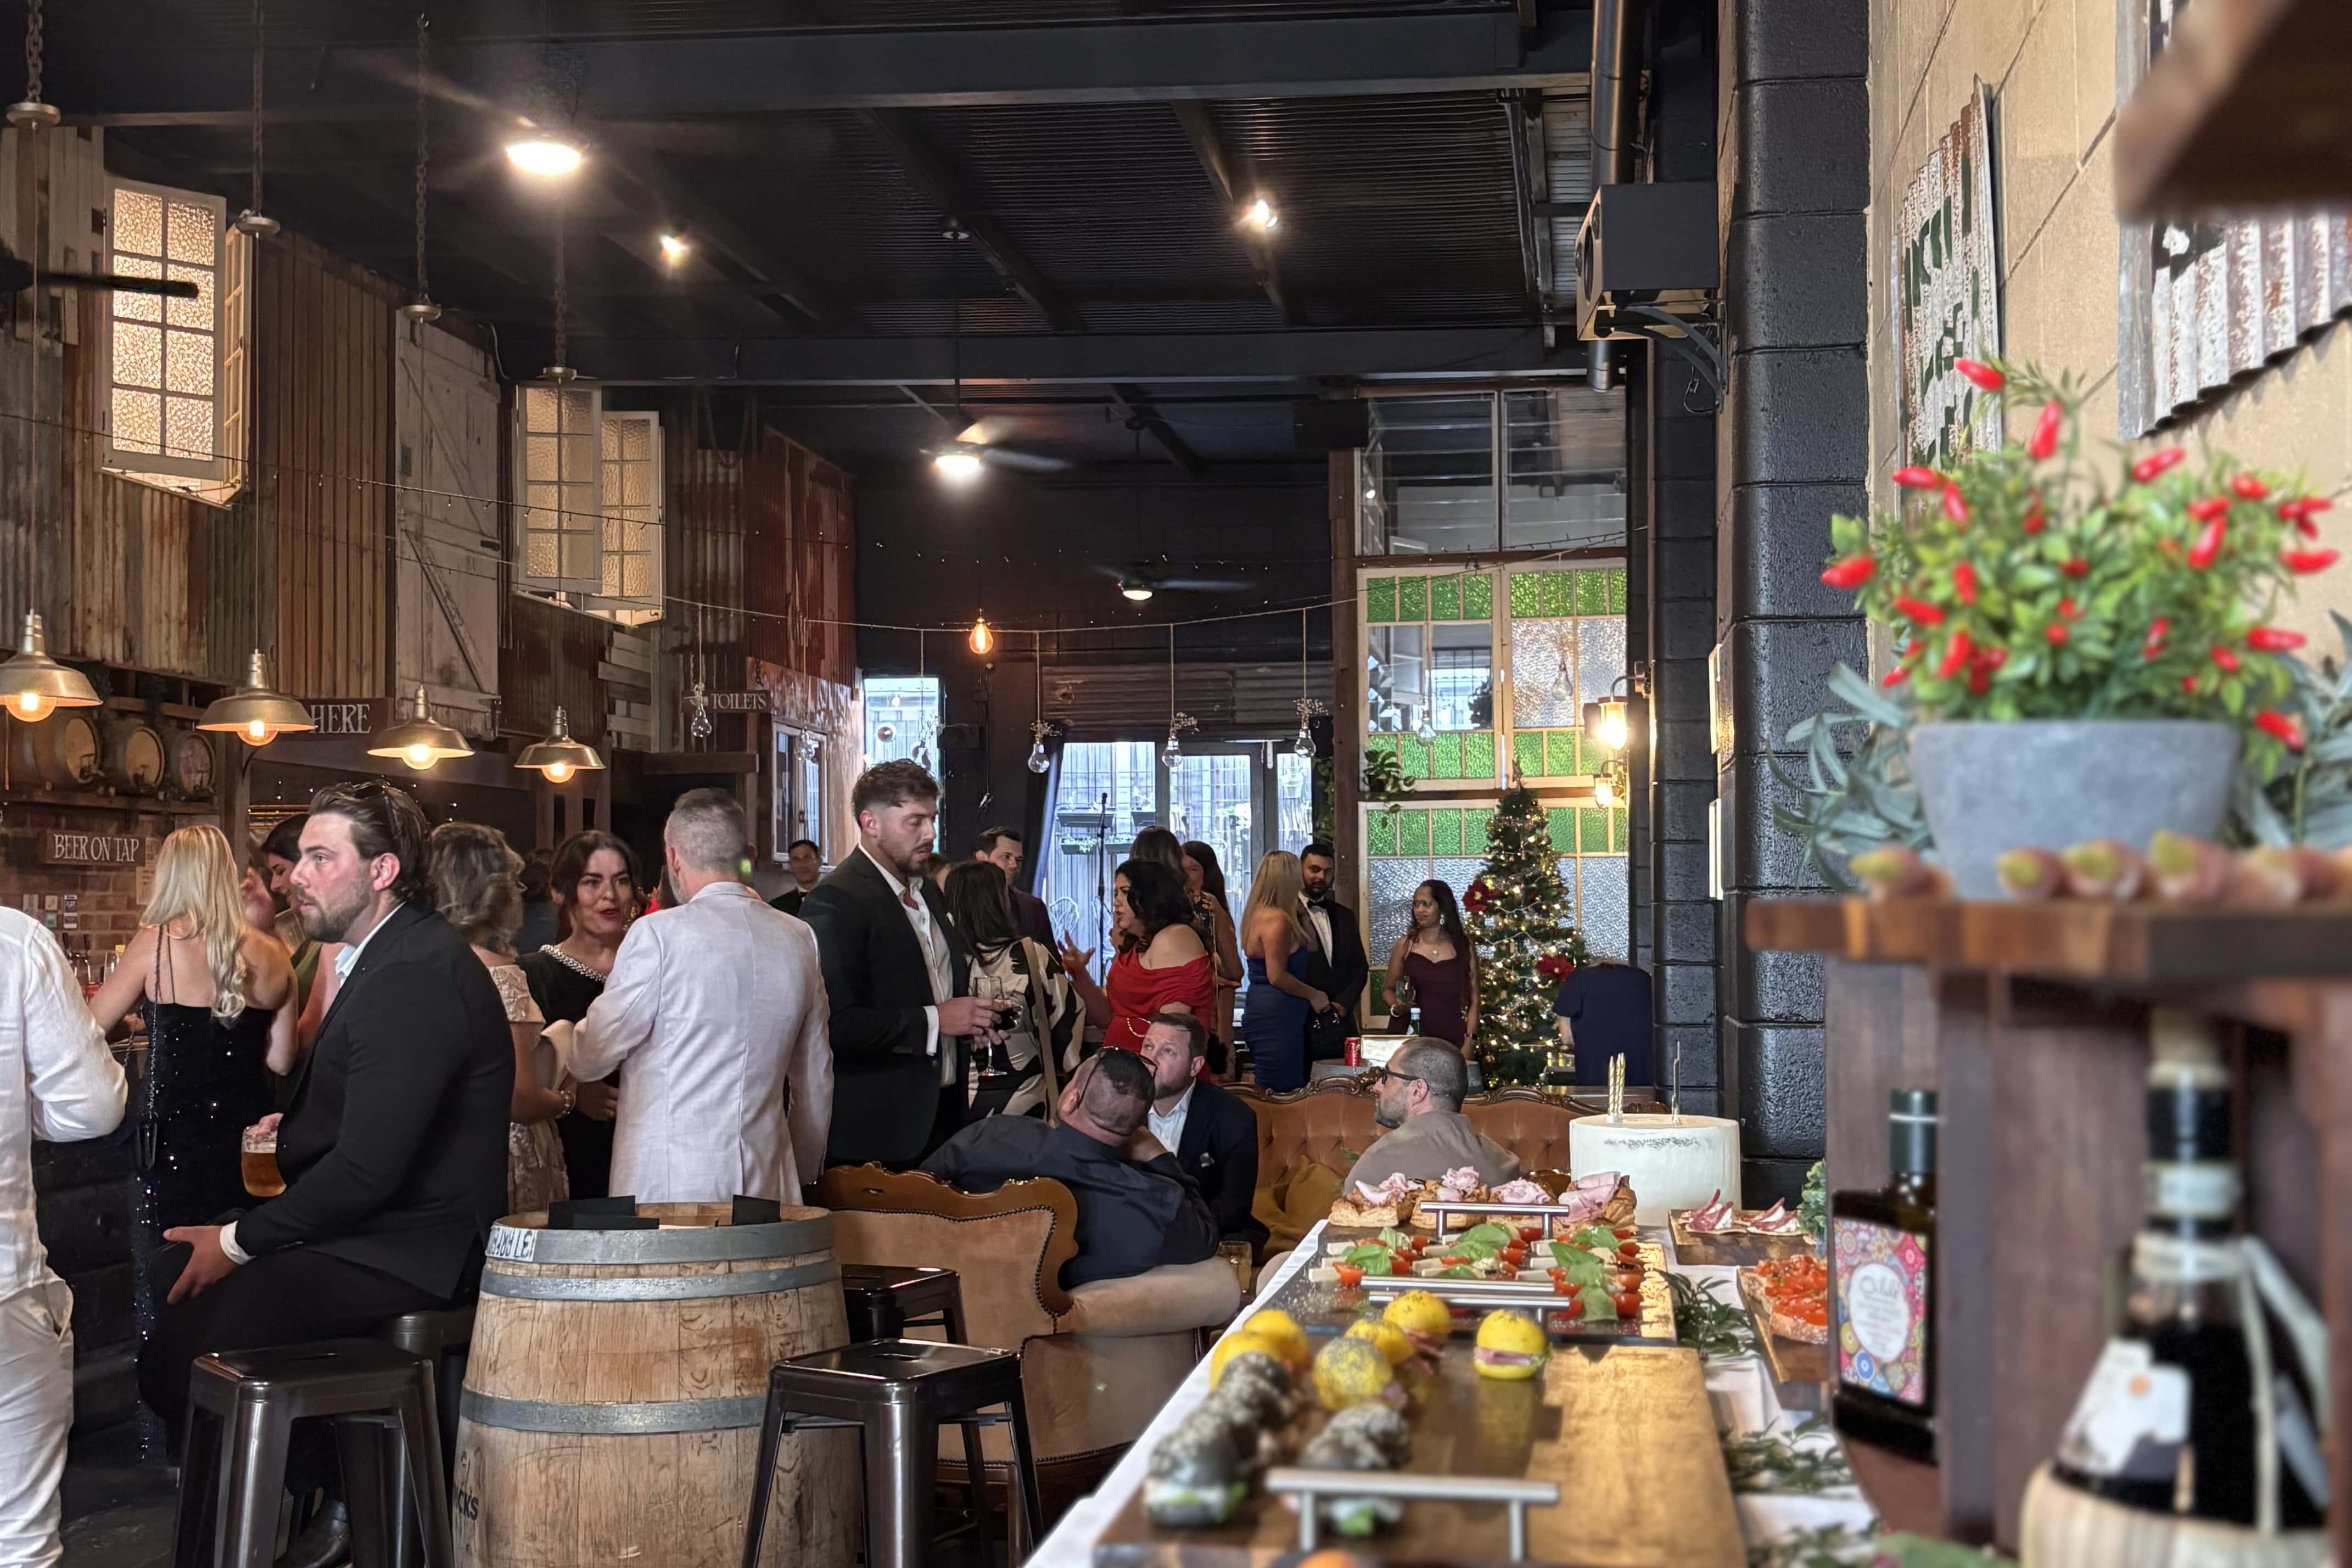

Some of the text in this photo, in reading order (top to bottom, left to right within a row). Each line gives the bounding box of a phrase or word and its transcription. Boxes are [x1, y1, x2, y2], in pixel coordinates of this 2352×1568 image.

[711, 693, 766, 710] TOILETS
[309, 703, 372, 734] HERE
[53, 833, 88, 860] BEER
[91, 837, 110, 861] ON
[114, 837, 139, 862] TAP
